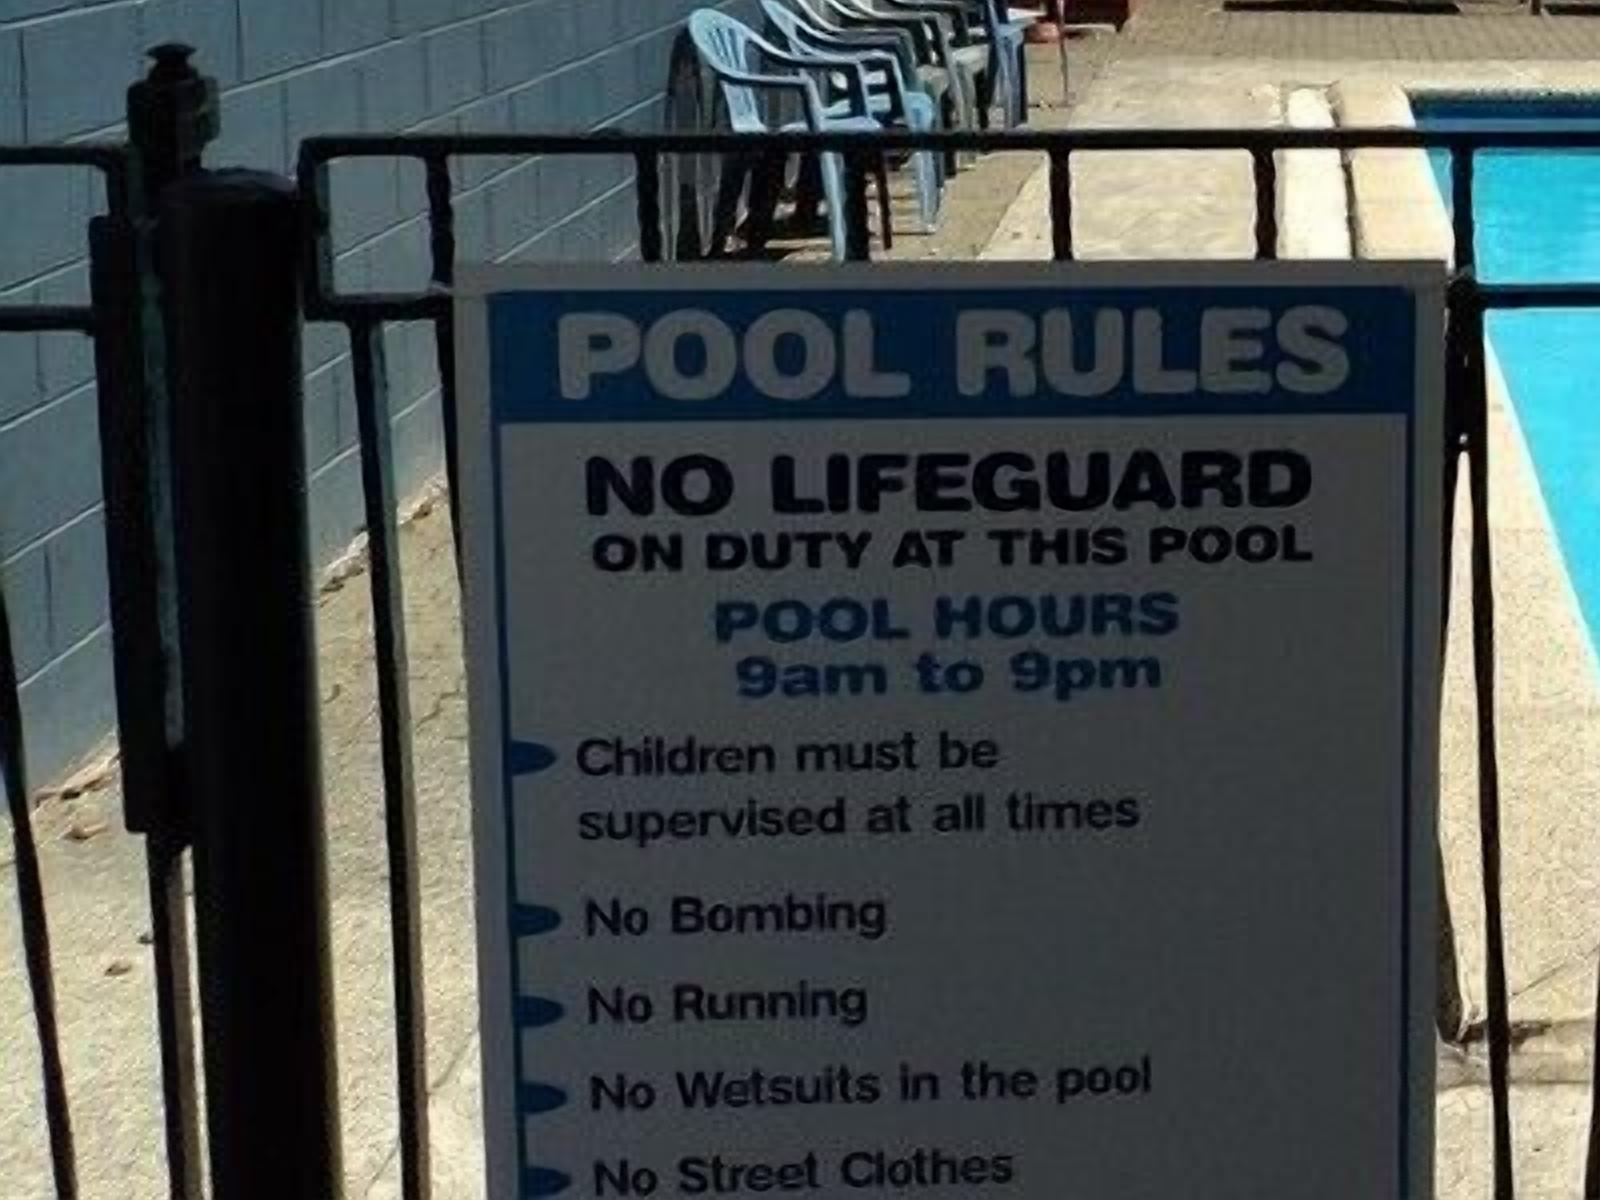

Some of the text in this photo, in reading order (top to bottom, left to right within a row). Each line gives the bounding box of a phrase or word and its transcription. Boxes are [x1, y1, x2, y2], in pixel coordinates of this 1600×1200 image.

[558, 306, 1349, 400] POOL RULES
[585, 448, 1312, 516] NO LIFEGUARD
[592, 525, 1313, 573] ON DUTY AT THIS POOL
[715, 591, 1179, 644] POOL HOURS
[735, 650, 1162, 702] 9am to 9pm
[577, 730, 1000, 777] Children must be
[578, 791, 1141, 847] supervised at all times
[586, 892, 886, 941] No Bombing
[588, 979, 868, 1029] No Running
[591, 1054, 1152, 1111] No Wetsuits in the pool
[593, 1148, 1015, 1197] No Street Clothes
